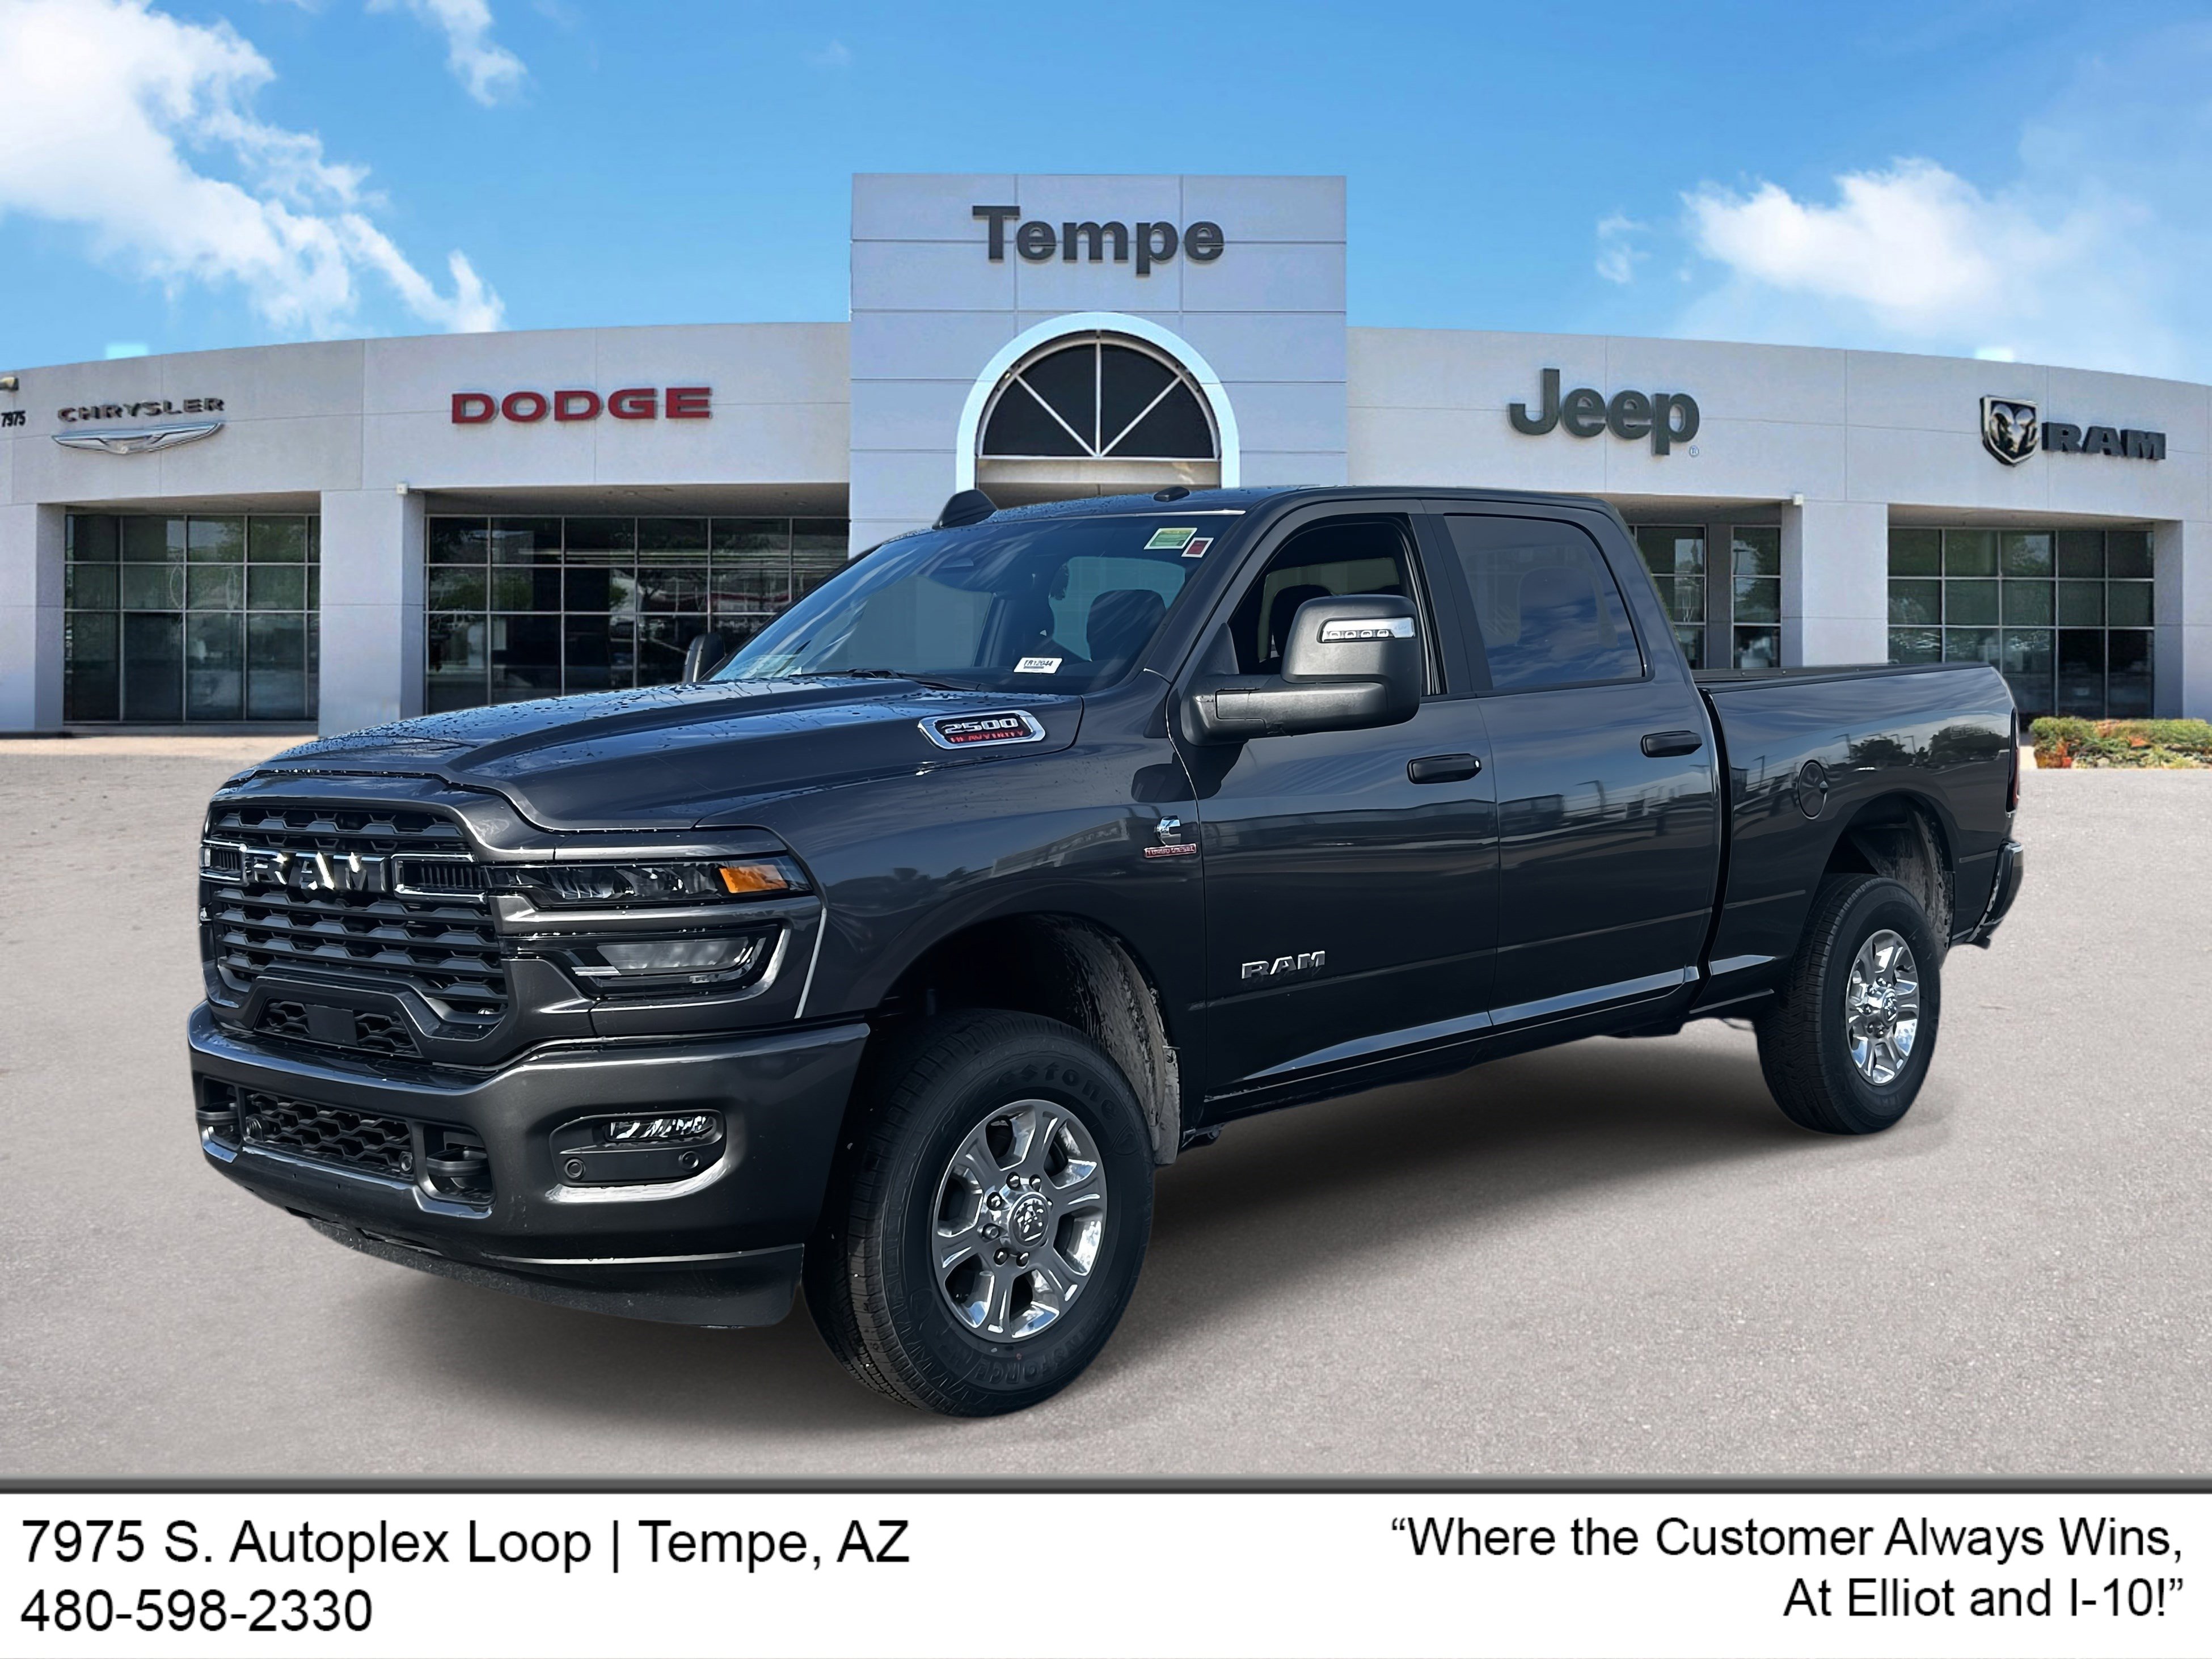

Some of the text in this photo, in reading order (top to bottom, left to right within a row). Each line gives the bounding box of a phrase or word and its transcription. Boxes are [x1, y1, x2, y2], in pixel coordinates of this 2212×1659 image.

[971, 205, 1225, 277] Tempe
[1, 410, 26, 427] 7975
[57, 398, 225, 422] CHRYSLER
[451, 386, 714, 424] DODGE
[1507, 368, 1700, 455] Jeep
[2041, 421, 2166, 461] RAM
[941, 717, 1019, 734] 2500
[243, 847, 389, 893] RAM
[1241, 950, 1325, 980] RAM
